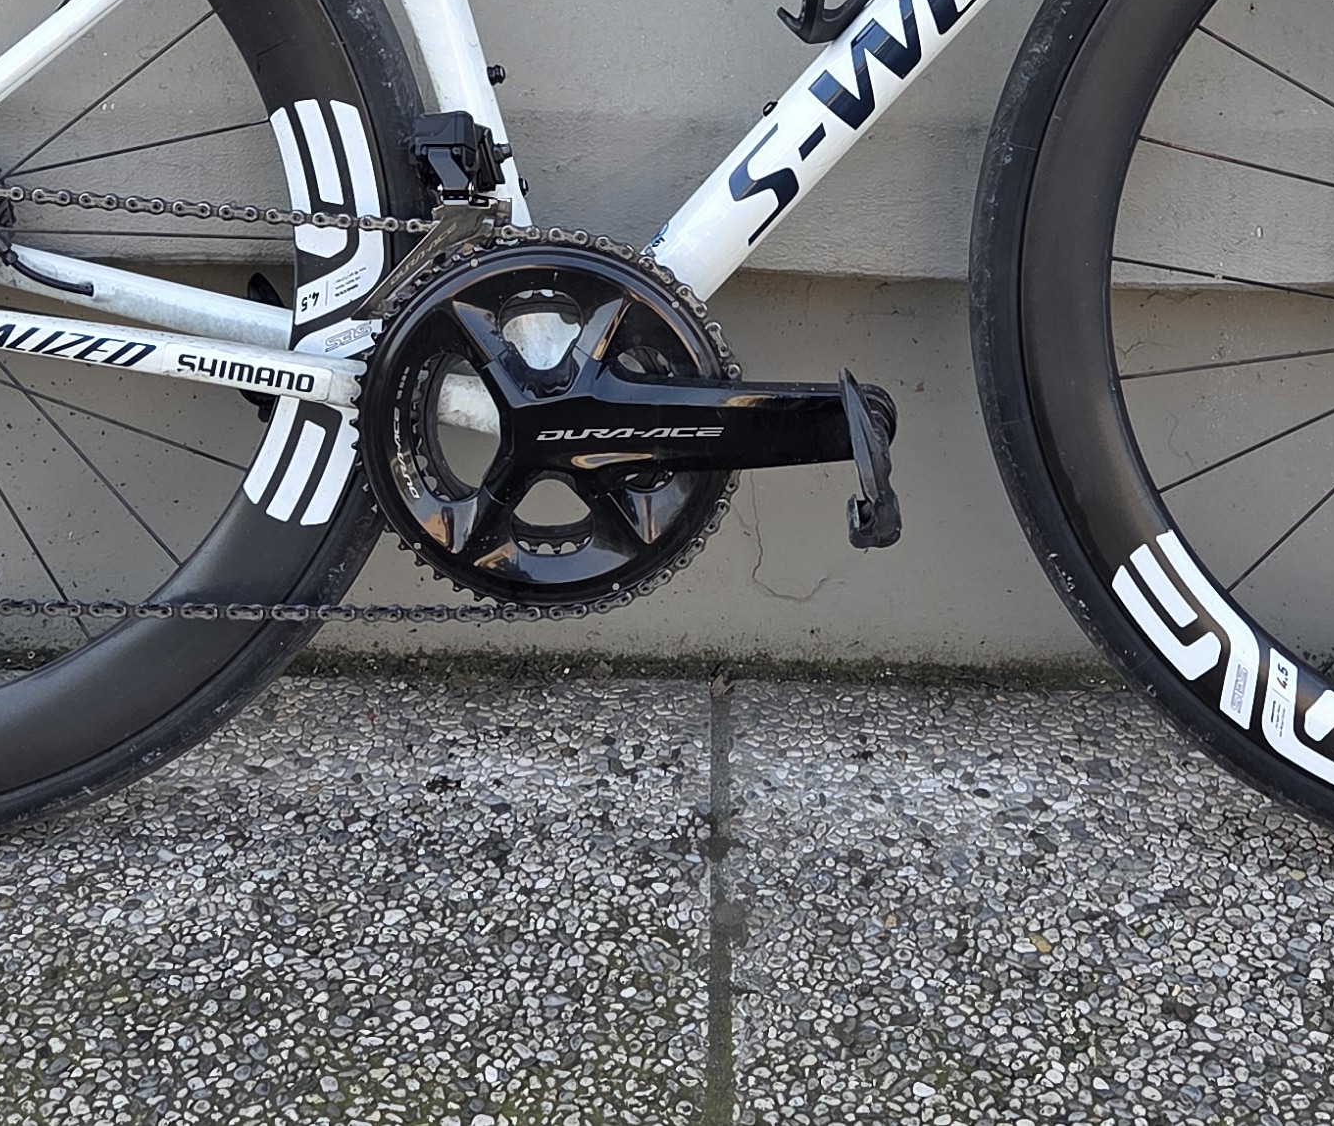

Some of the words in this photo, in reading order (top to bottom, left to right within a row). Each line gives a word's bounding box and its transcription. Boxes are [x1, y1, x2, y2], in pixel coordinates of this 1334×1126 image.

[301, 292, 320, 312] 4.5
[177, 352, 316, 393] SHIMANO
[536, 426, 725, 441] DURA-ACE
[393, 407, 421, 499] DURA-ACE
[1276, 662, 1289, 690] 4.5
